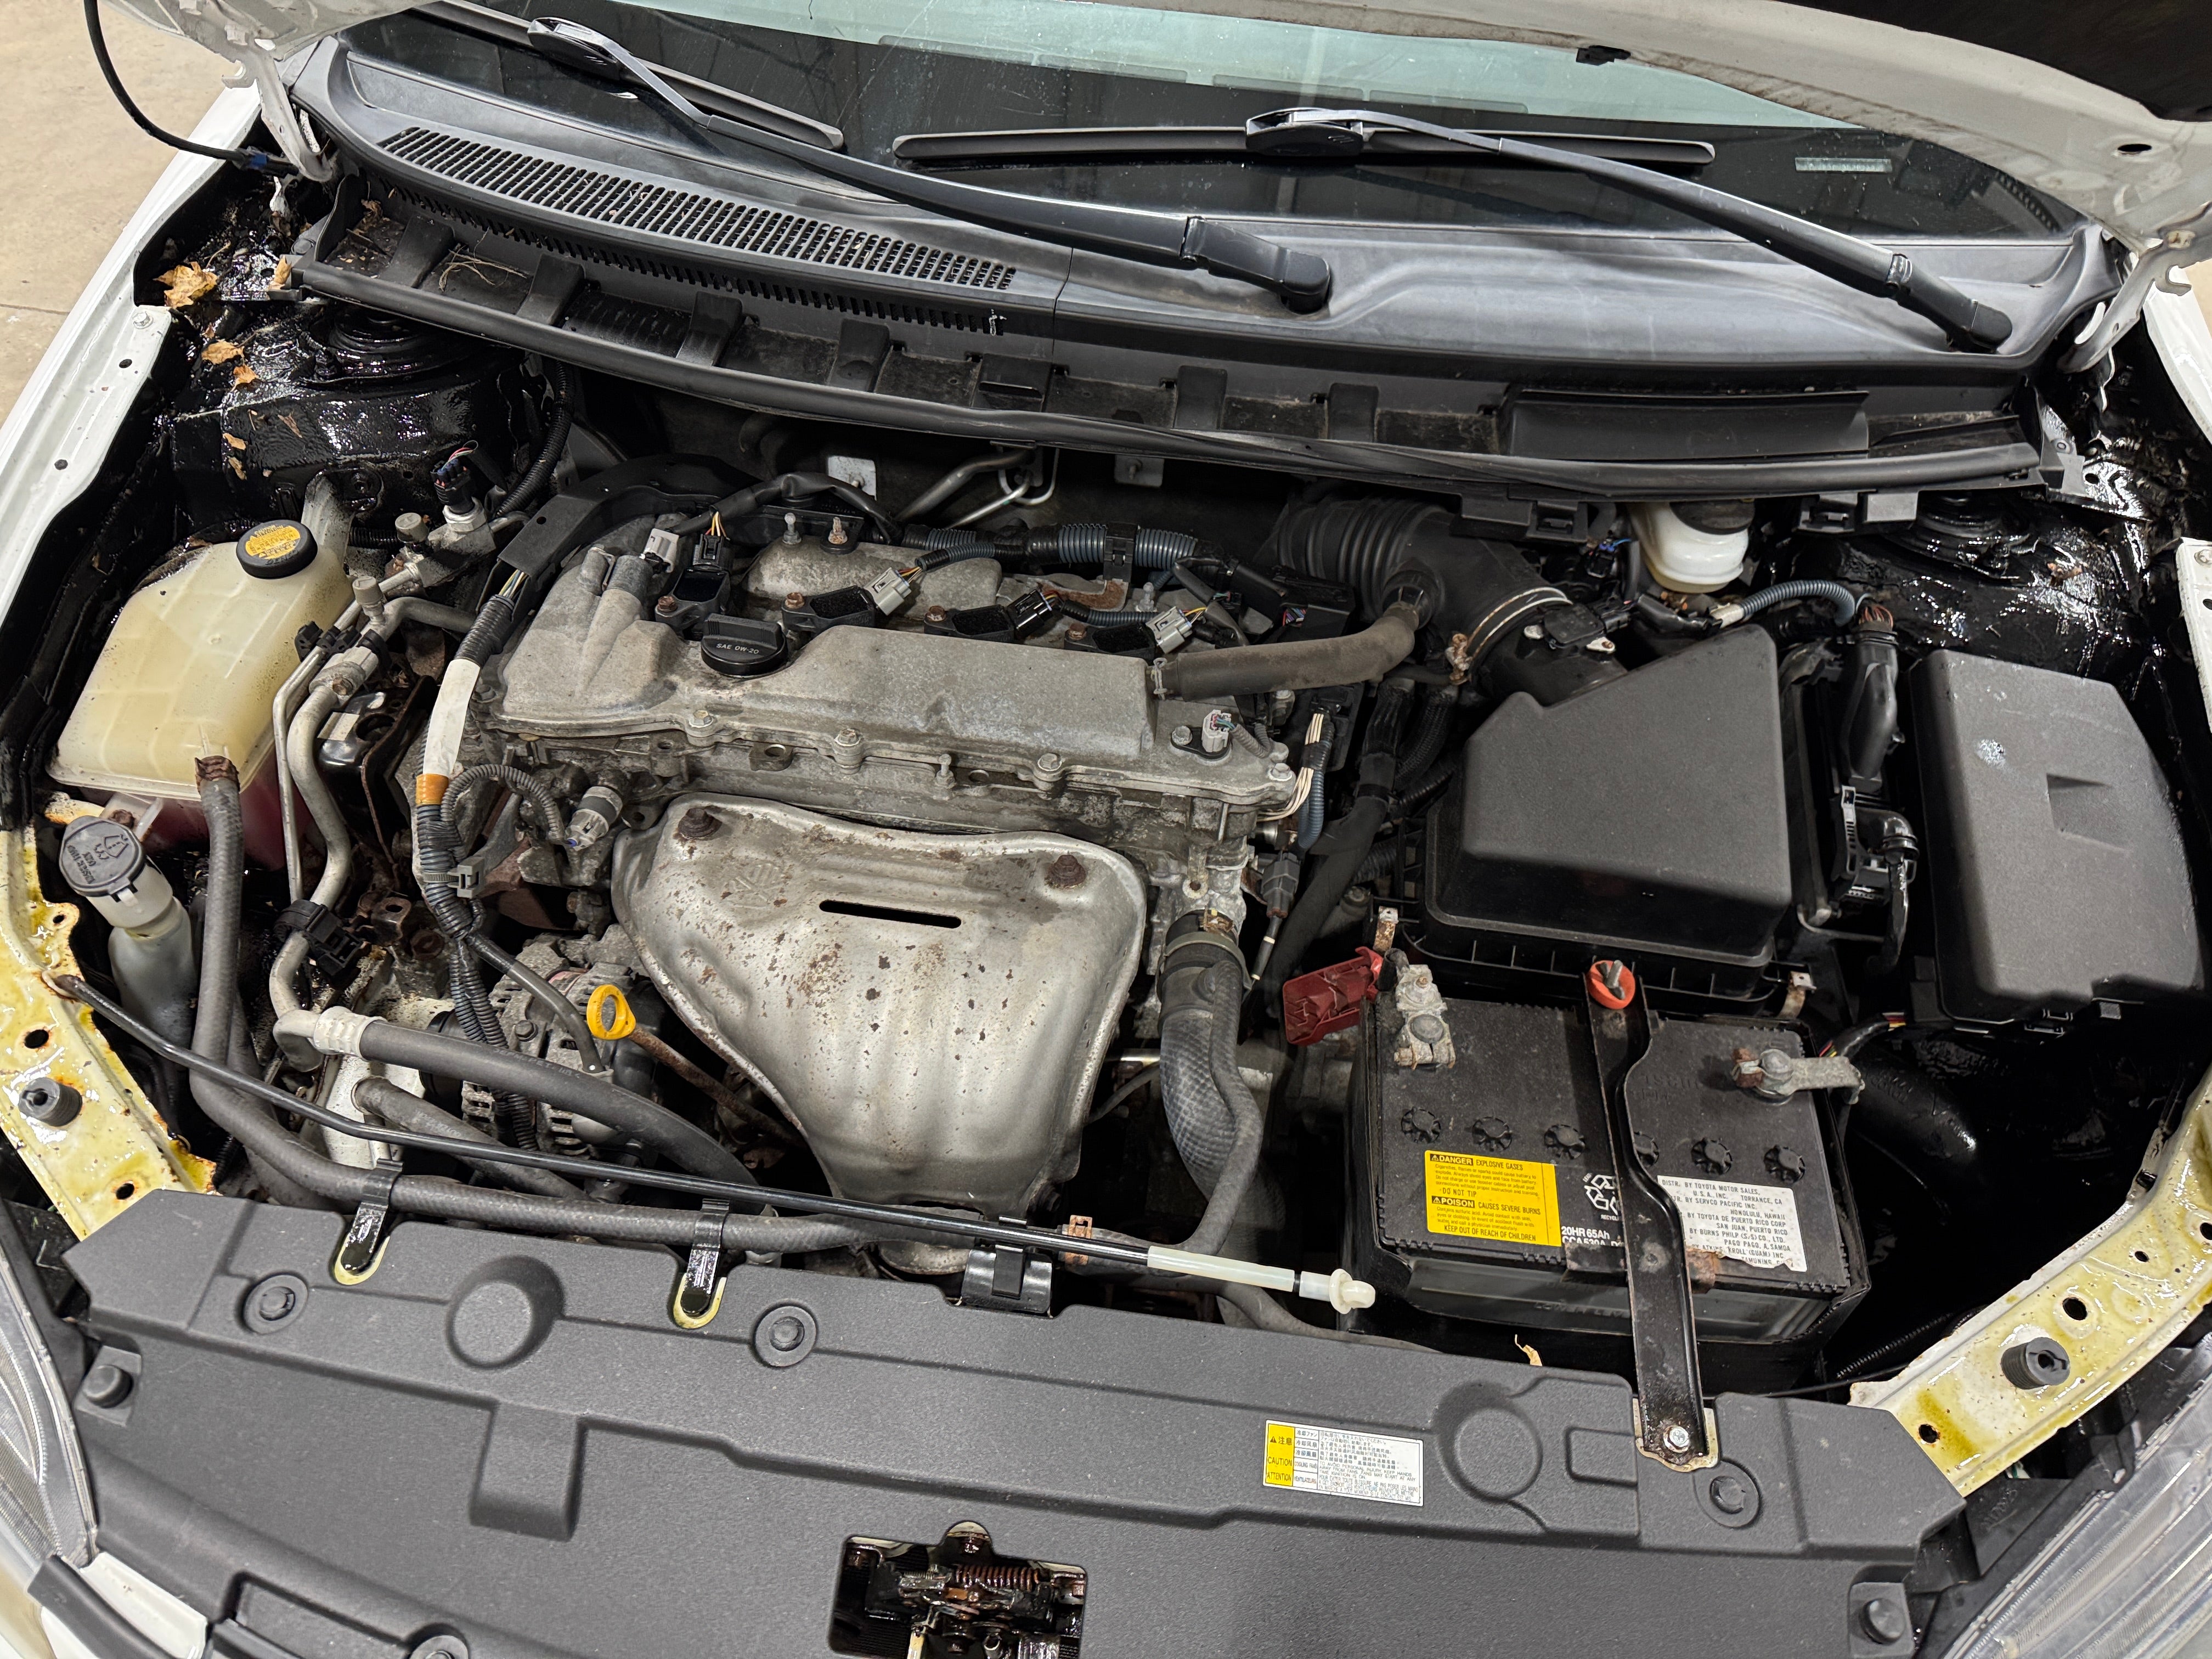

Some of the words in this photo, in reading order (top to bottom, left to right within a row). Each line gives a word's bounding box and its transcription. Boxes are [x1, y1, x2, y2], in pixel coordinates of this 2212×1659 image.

[265, 550, 298, 566] DENSO
[1439, 1155, 1471, 1165] DANGER
[1476, 1159, 1504, 1169] EXPLOSIVE
[1506, 1163, 1523, 1171] GASES
[1695, 1182, 1716, 1190] TOYOTA
[1740, 1187, 1760, 1195] SALES,
[1741, 1195, 1773, 1204] TORRANCE,
[1441, 1198, 1474, 1207] POISON
[1478, 1201, 1499, 1210] CAUSES
[1501, 1204, 1521, 1213] SEVERE
[1522, 1206, 1541, 1215] BURNS
[1697, 1213, 1719, 1221] TOYOTA
[1731, 1216, 1753, 1224] PUERTO
[1730, 1209, 1762, 1218] HONOLULU,
[1764, 1212, 1785, 1220] HAWAII
[1480, 1228, 1498, 1237] REACH
[1509, 1232, 1536, 1241] CHILDREN
[1728, 1246, 1745, 1255] KROLL
[1748, 1249, 1770, 1257] (GUAM)
[1278, 1436, 1293, 1446] 注意
[1268, 1456, 1292, 1466] CAUTION
[1267, 1472, 1291, 1482] ATTENTION
